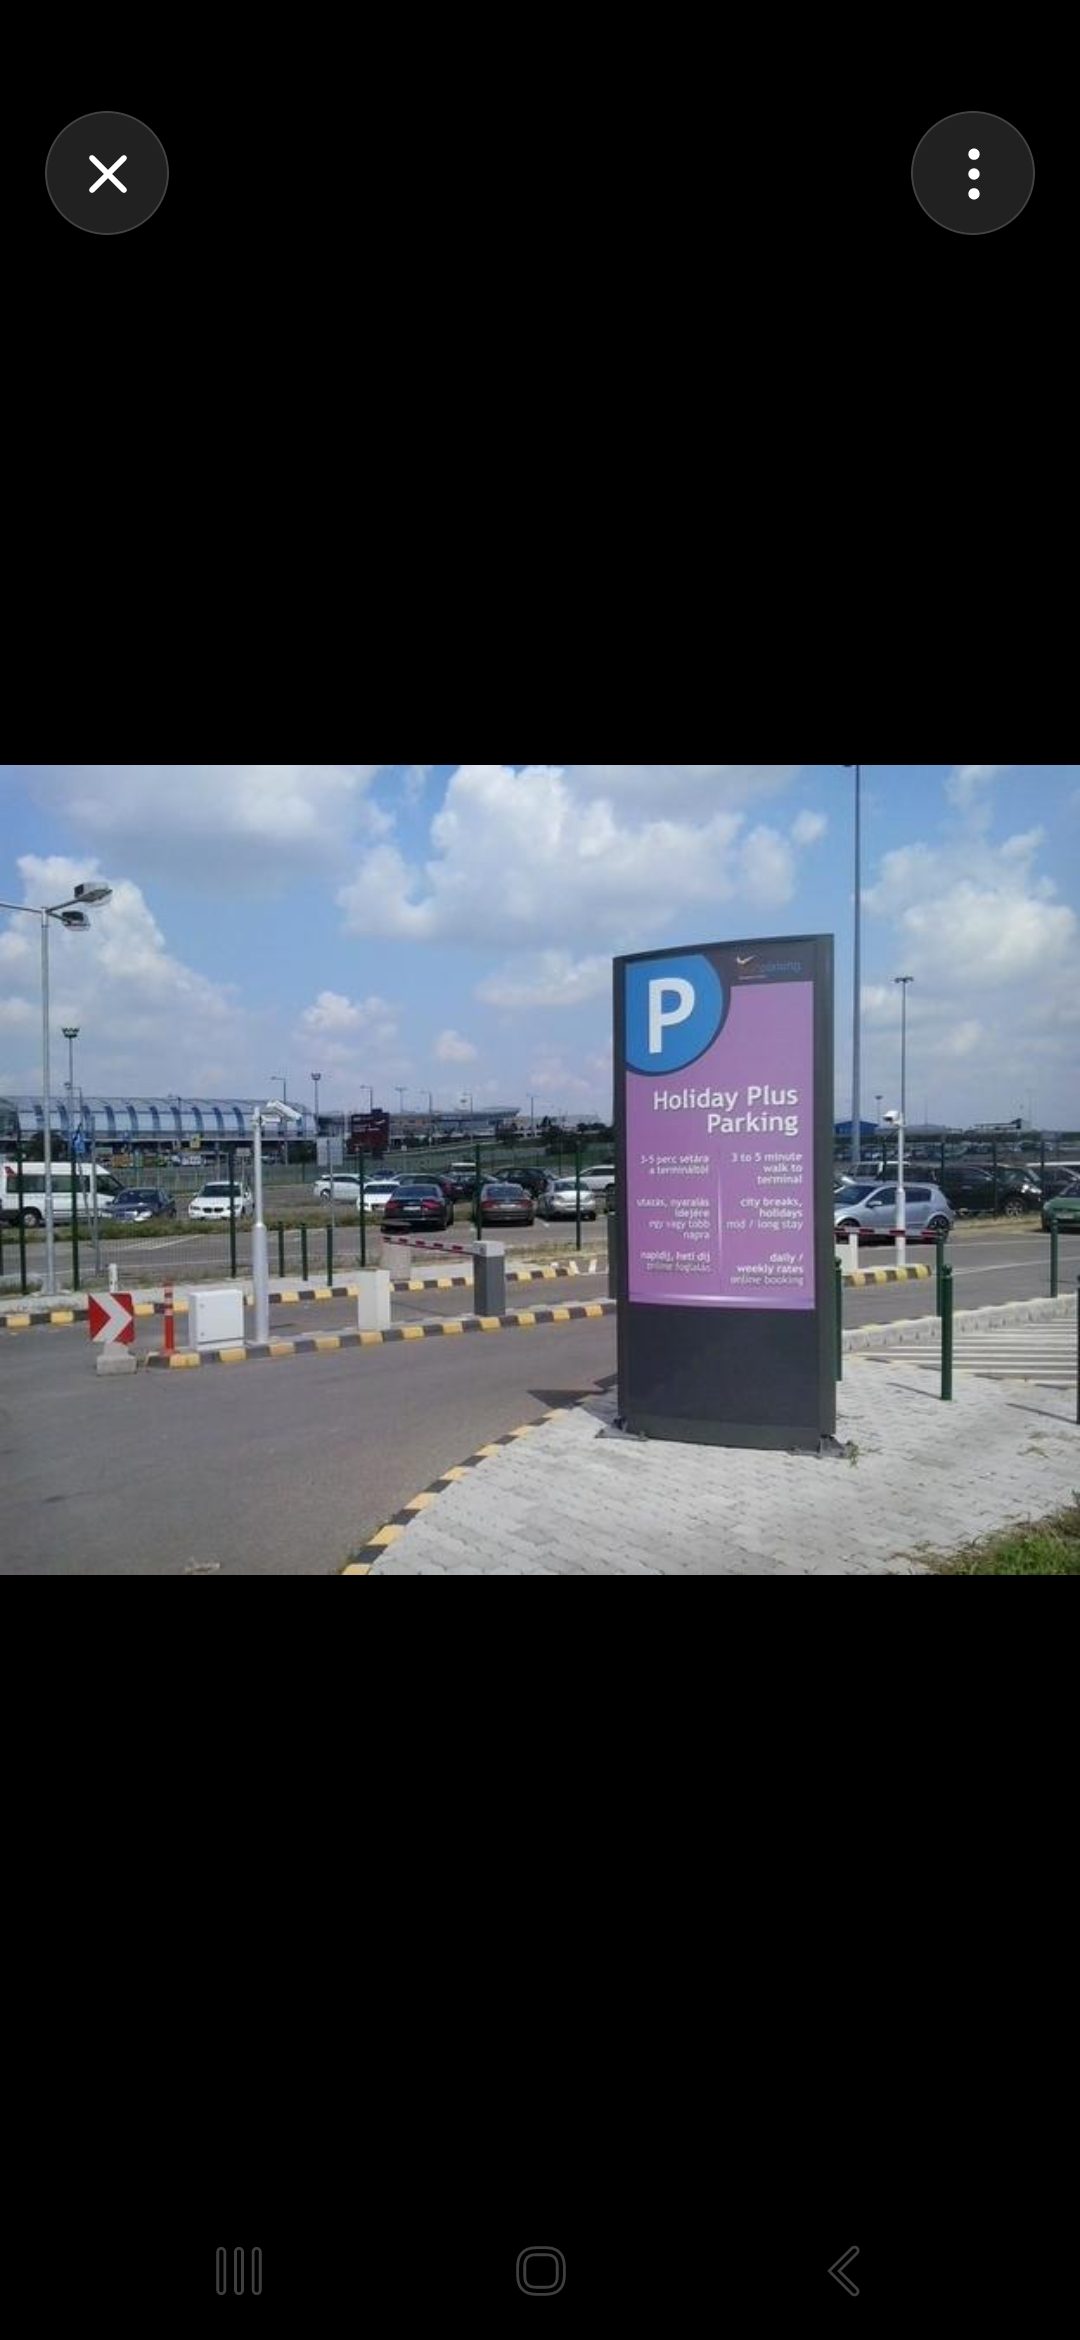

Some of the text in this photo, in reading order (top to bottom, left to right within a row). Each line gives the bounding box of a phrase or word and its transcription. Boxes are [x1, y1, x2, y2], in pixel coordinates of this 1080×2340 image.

[648, 977, 695, 1054] P
[653, 1085, 798, 1111] Holiday Plus
[707, 1113, 799, 1135] Parking
[731, 1152, 803, 1162] 3 to 5 minute
[763, 1163, 803, 1173] walk to
[757, 1174, 803, 1185] terminal
[740, 1197, 803, 1208] city breaks,
[759, 1208, 803, 1218] holidays
[757, 1219, 780, 1230] long
[781, 1219, 803, 1230] stay
[769, 1253, 796, 1264] daily
[736, 1264, 804, 1274] weekly rates
[730, 1275, 804, 1287] online booking
